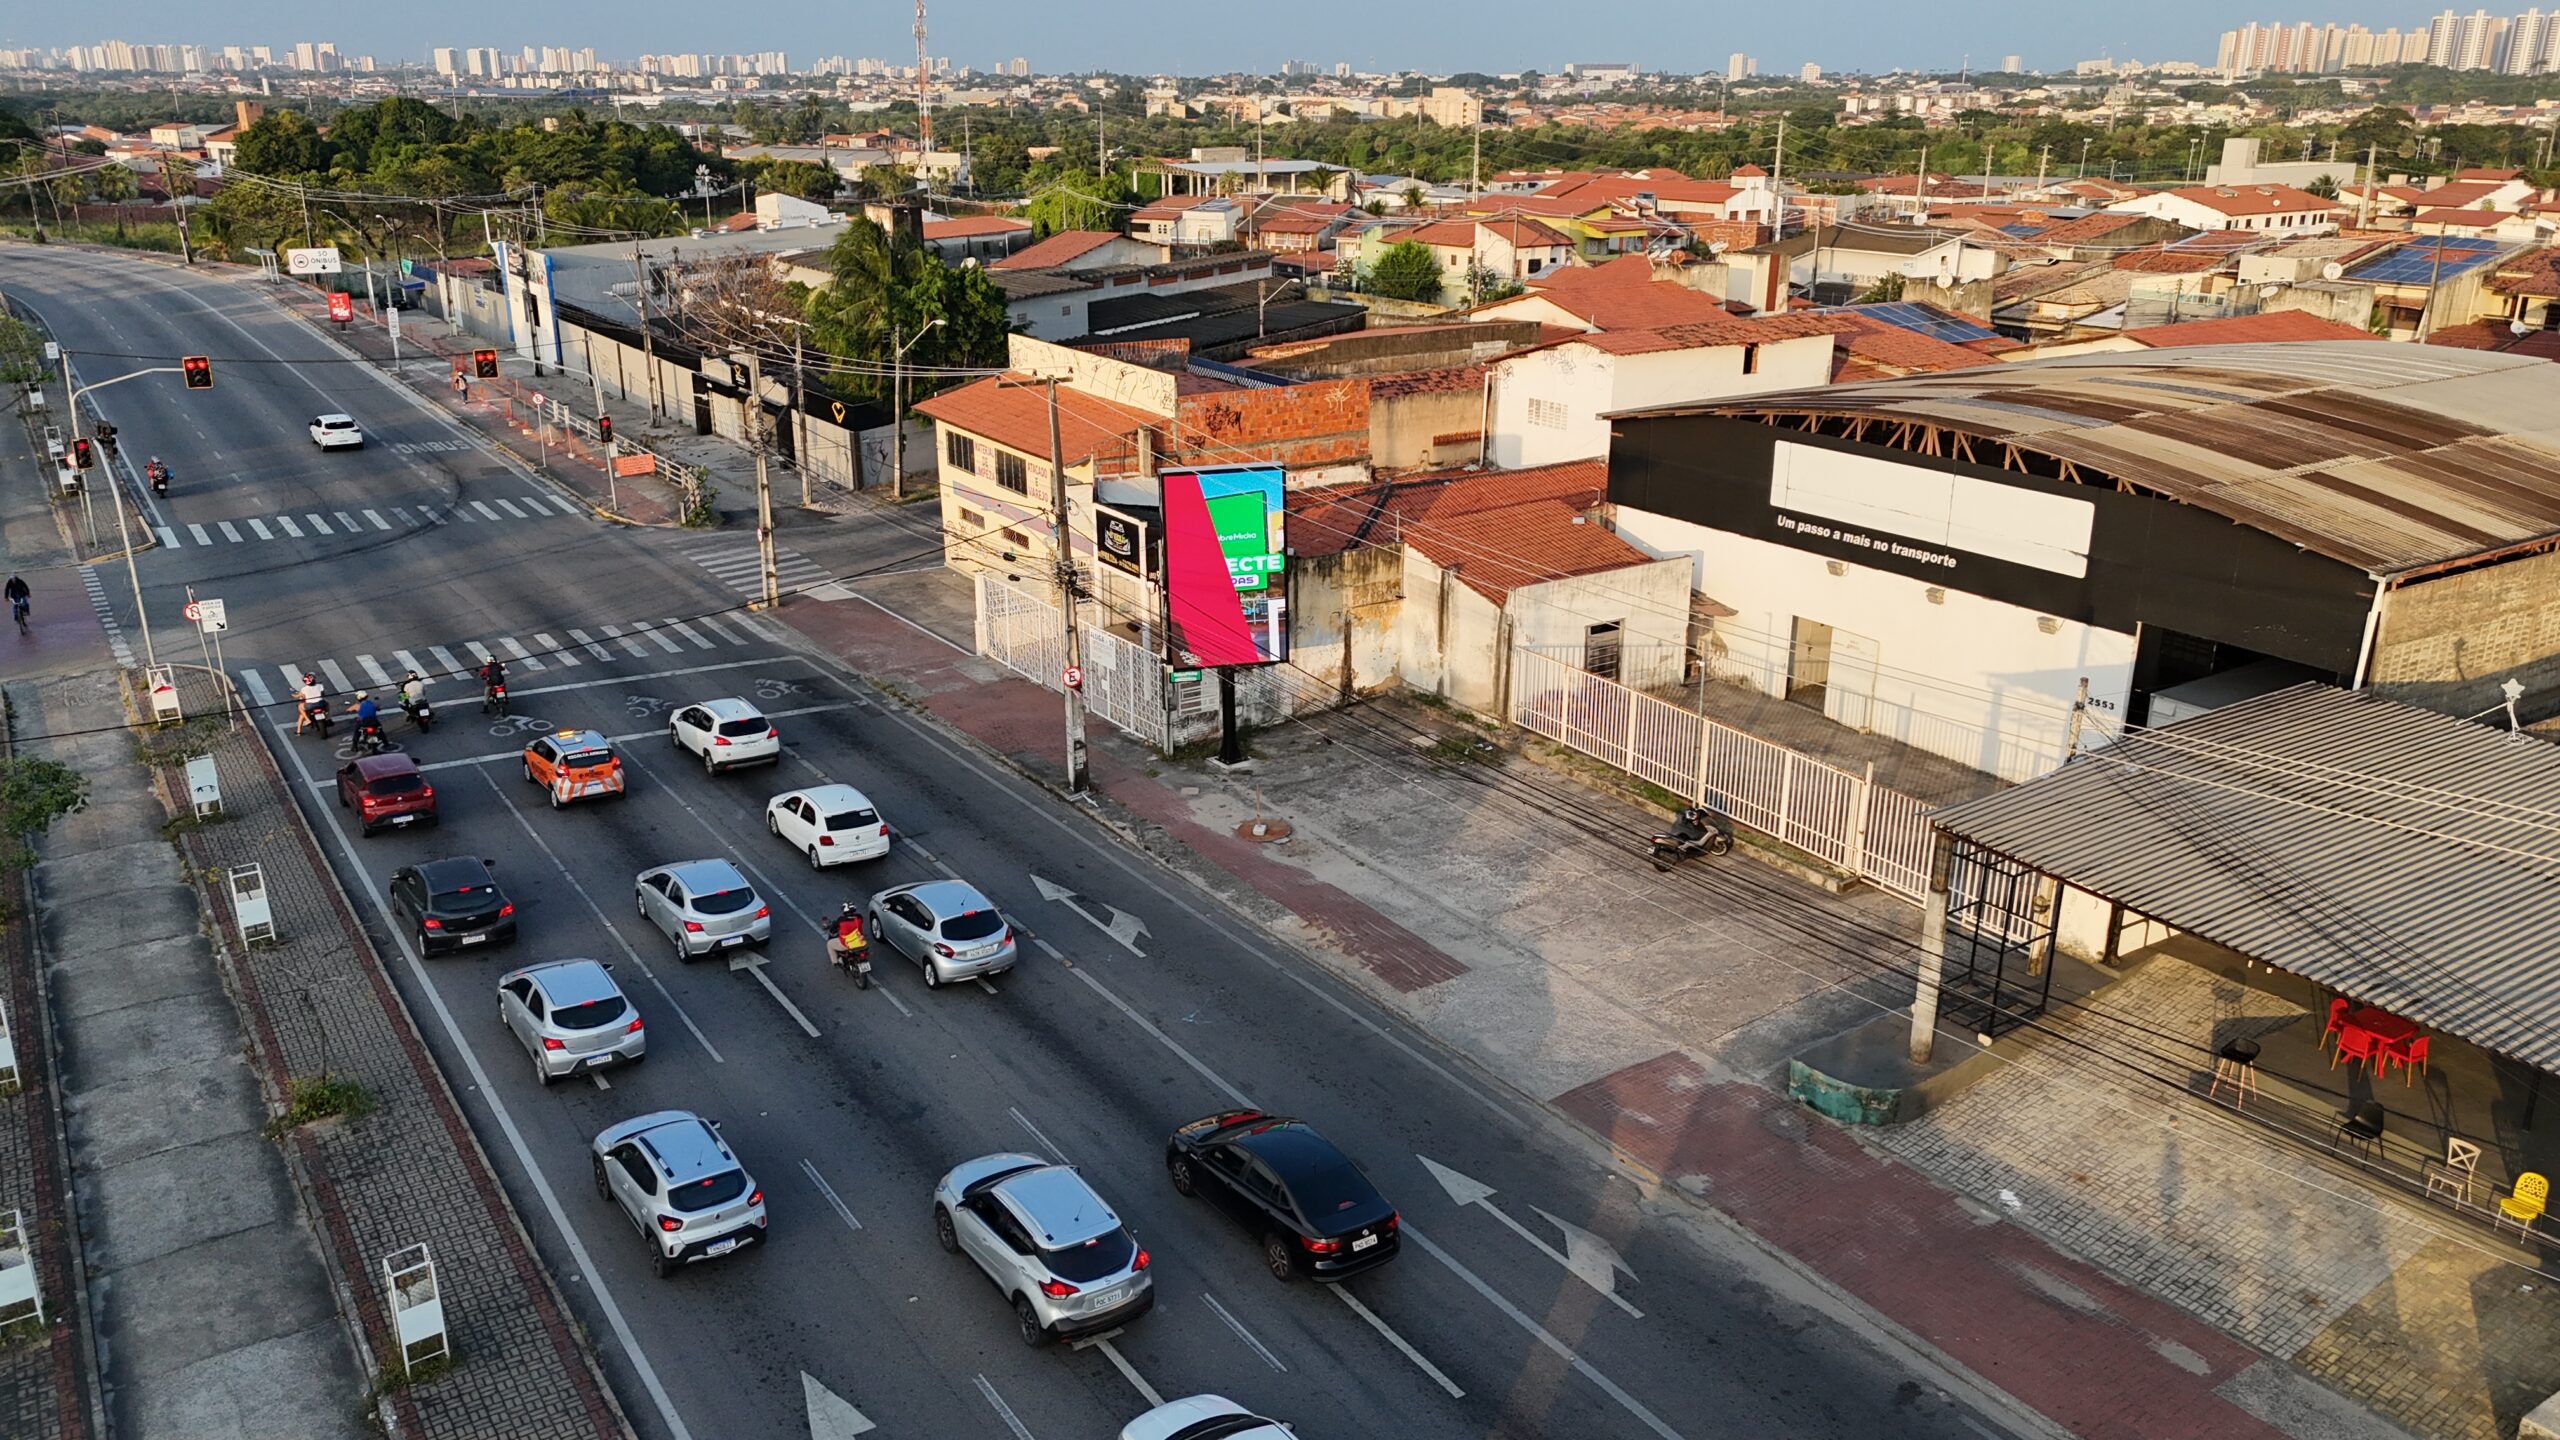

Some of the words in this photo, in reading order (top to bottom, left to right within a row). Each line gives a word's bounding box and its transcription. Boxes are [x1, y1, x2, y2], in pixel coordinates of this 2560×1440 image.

[1777, 514, 1796, 530] Um
[1796, 521, 1831, 538] passo
[1832, 530, 1841, 540] a
[1842, 532, 1871, 548] mais
[1872, 539, 1889, 552] no
[1890, 542, 1957, 568] transporte
[2088, 697, 2115, 710] 2553
